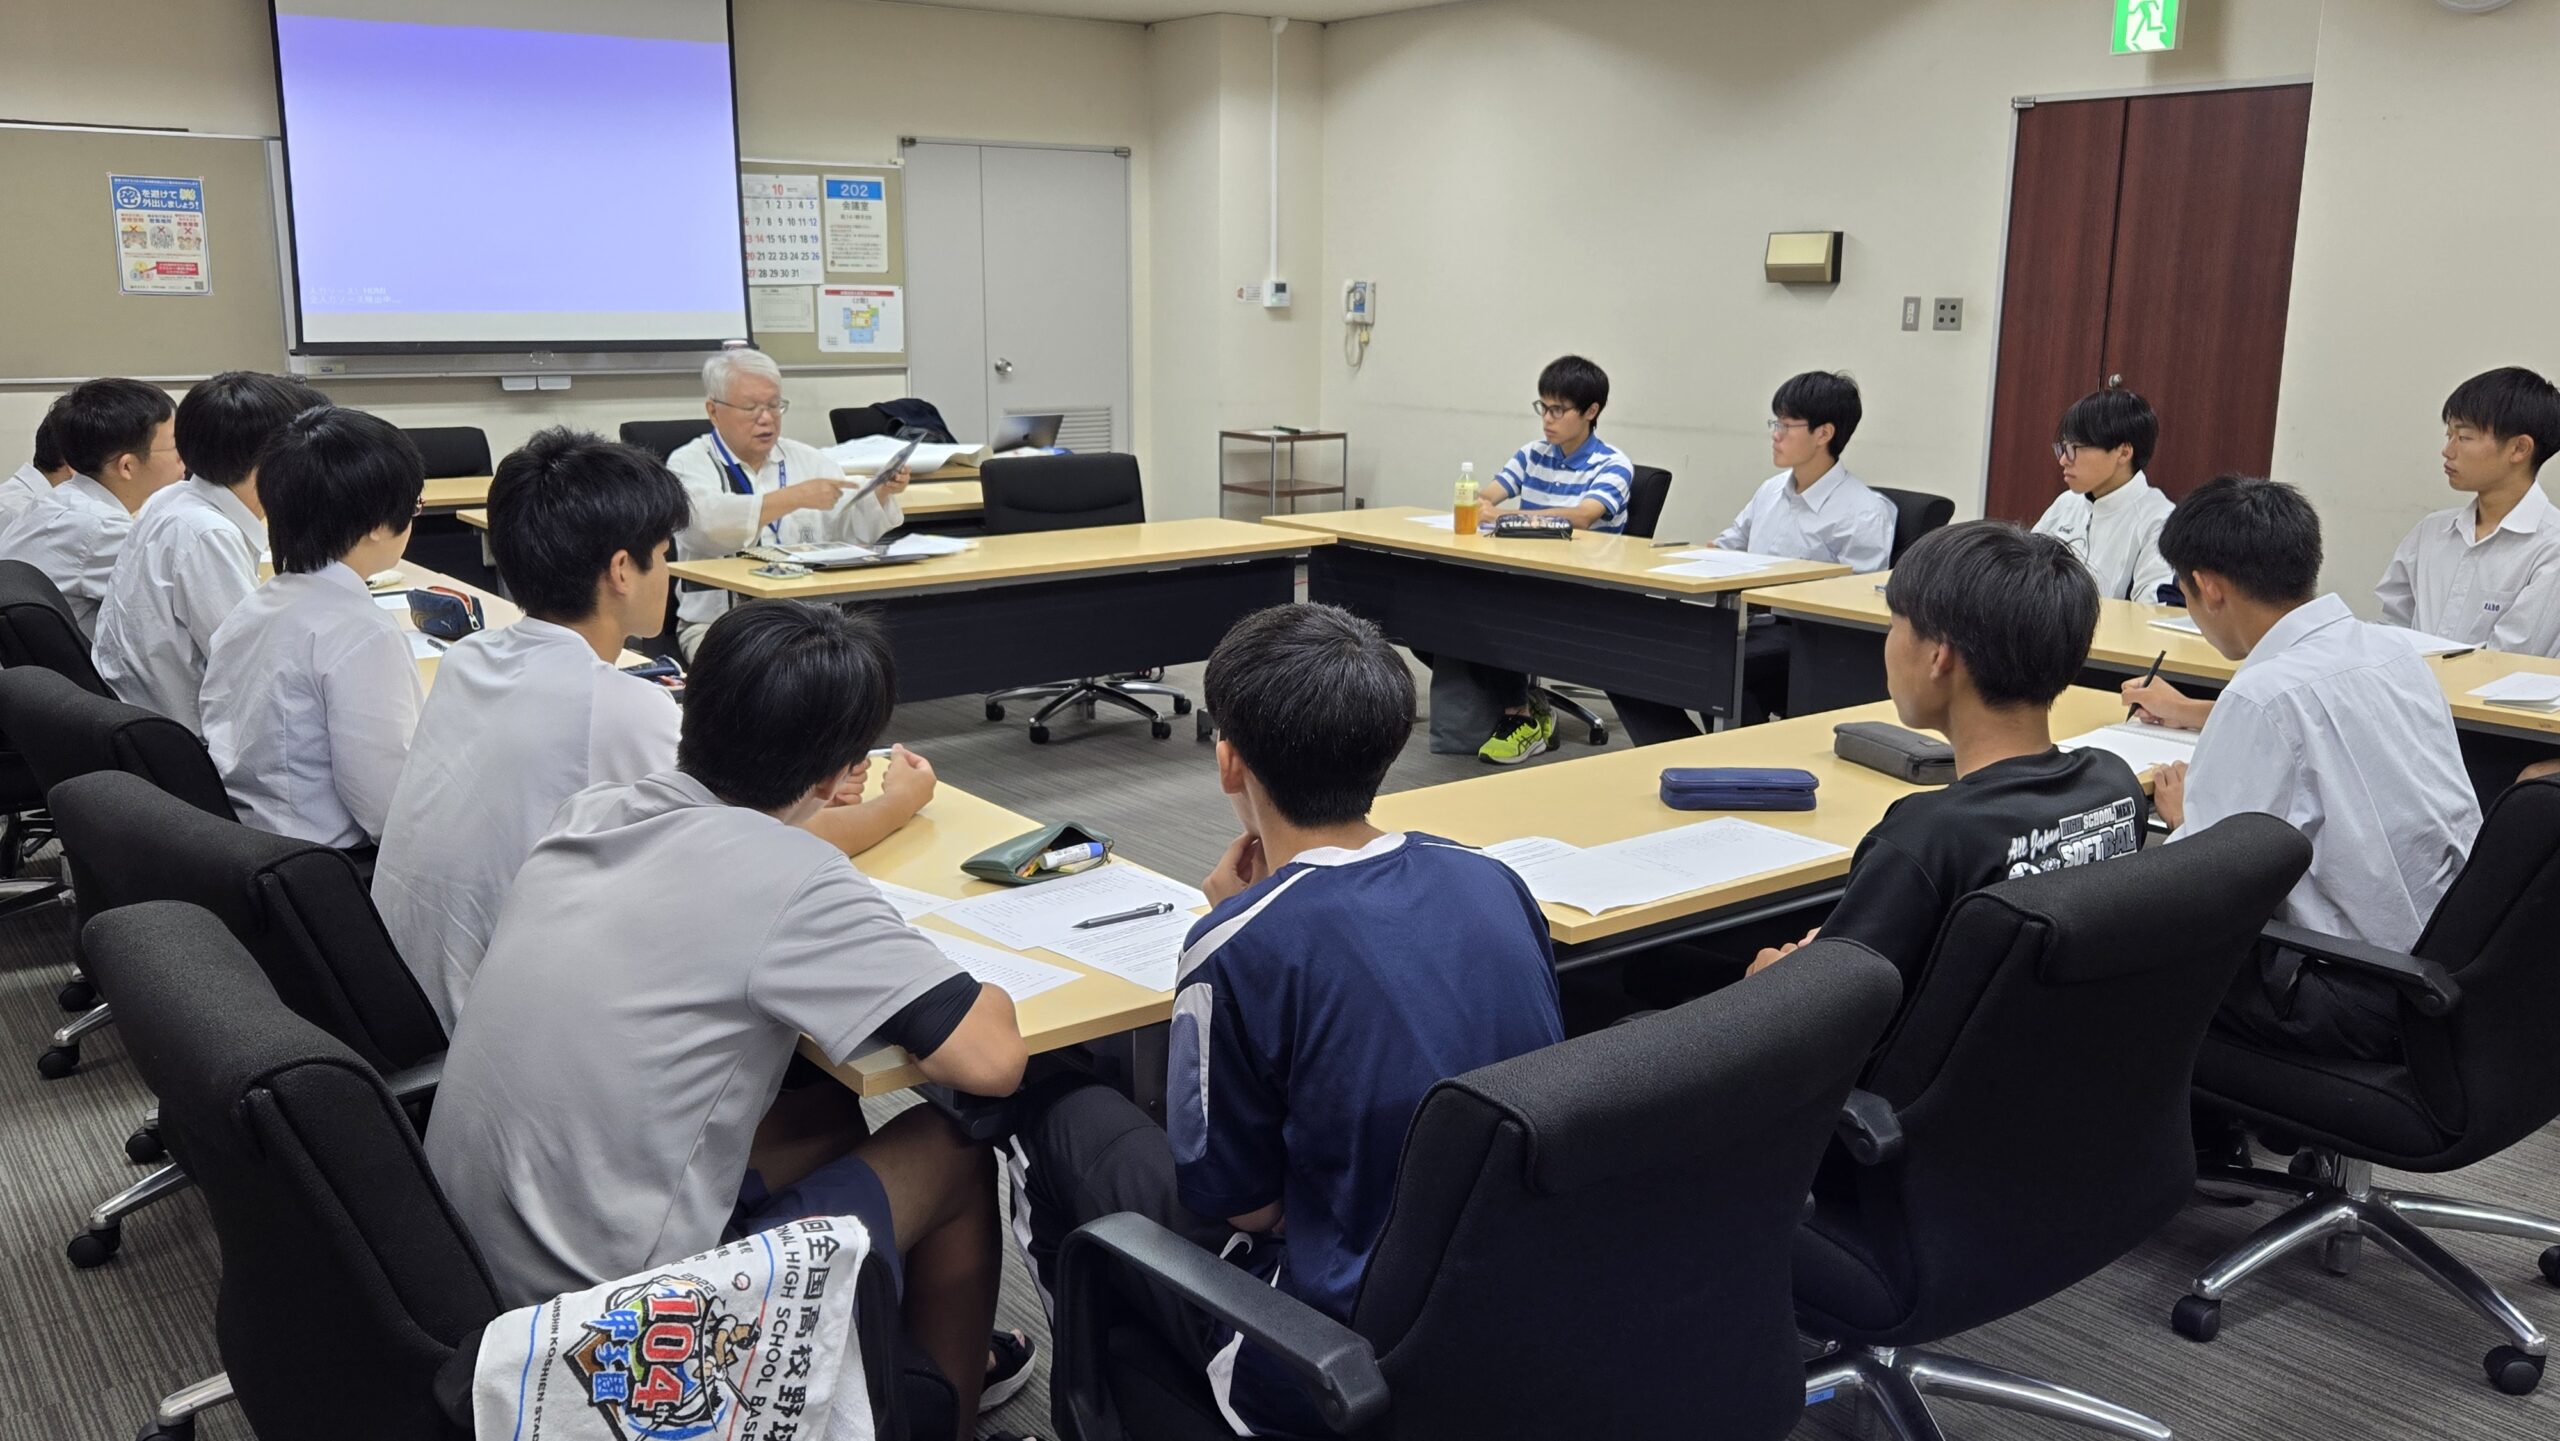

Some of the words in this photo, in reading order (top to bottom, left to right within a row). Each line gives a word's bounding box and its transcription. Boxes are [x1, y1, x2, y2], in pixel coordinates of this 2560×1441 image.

[772, 184, 784, 196] 10
[840, 183, 869, 197] 202
[766, 200, 770, 209] 1
[776, 200, 781, 209] 2
[787, 200, 792, 209] 3
[798, 200, 804, 209] 4
[809, 200, 815, 209] 5
[842, 201, 871, 211] 会議室
[744, 217, 750, 226] 6
[755, 217, 760, 226] 7
[767, 217, 772, 226] 8
[778, 217, 783, 226] 9
[787, 217, 796, 226] 10
[798, 217, 806, 226] 11
[809, 217, 817, 226] 12
[755, 235, 764, 244] 14
[766, 235, 775, 244] 15
[778, 235, 787, 244] 16
[789, 235, 797, 244] 17
[799, 235, 808, 244] 18
[810, 235, 819, 244] 19
[757, 252, 766, 261] 21
[768, 252, 777, 261] 22
[779, 252, 788, 261] 23
[790, 252, 799, 261] 24
[801, 252, 809, 261] 25
[811, 252, 820, 261] 26
[747, 269, 756, 278] 27
[758, 269, 767, 278] 28
[769, 269, 778, 278] 29
[780, 269, 789, 278] 30
[791, 269, 800, 278] 31
[2061, 815, 2082, 837] HIGH
[2082, 805, 2115, 830] SCHOOL
[2006, 835, 2029, 865] All
[780, 1251, 801, 1300] HIGH
[680, 1272, 717, 1295] 2022
[756, 1306, 791, 1388] SCHOOL
[587, 1308, 641, 1402] 甲子園
[537, 1336, 559, 1402] KOSHIEN
